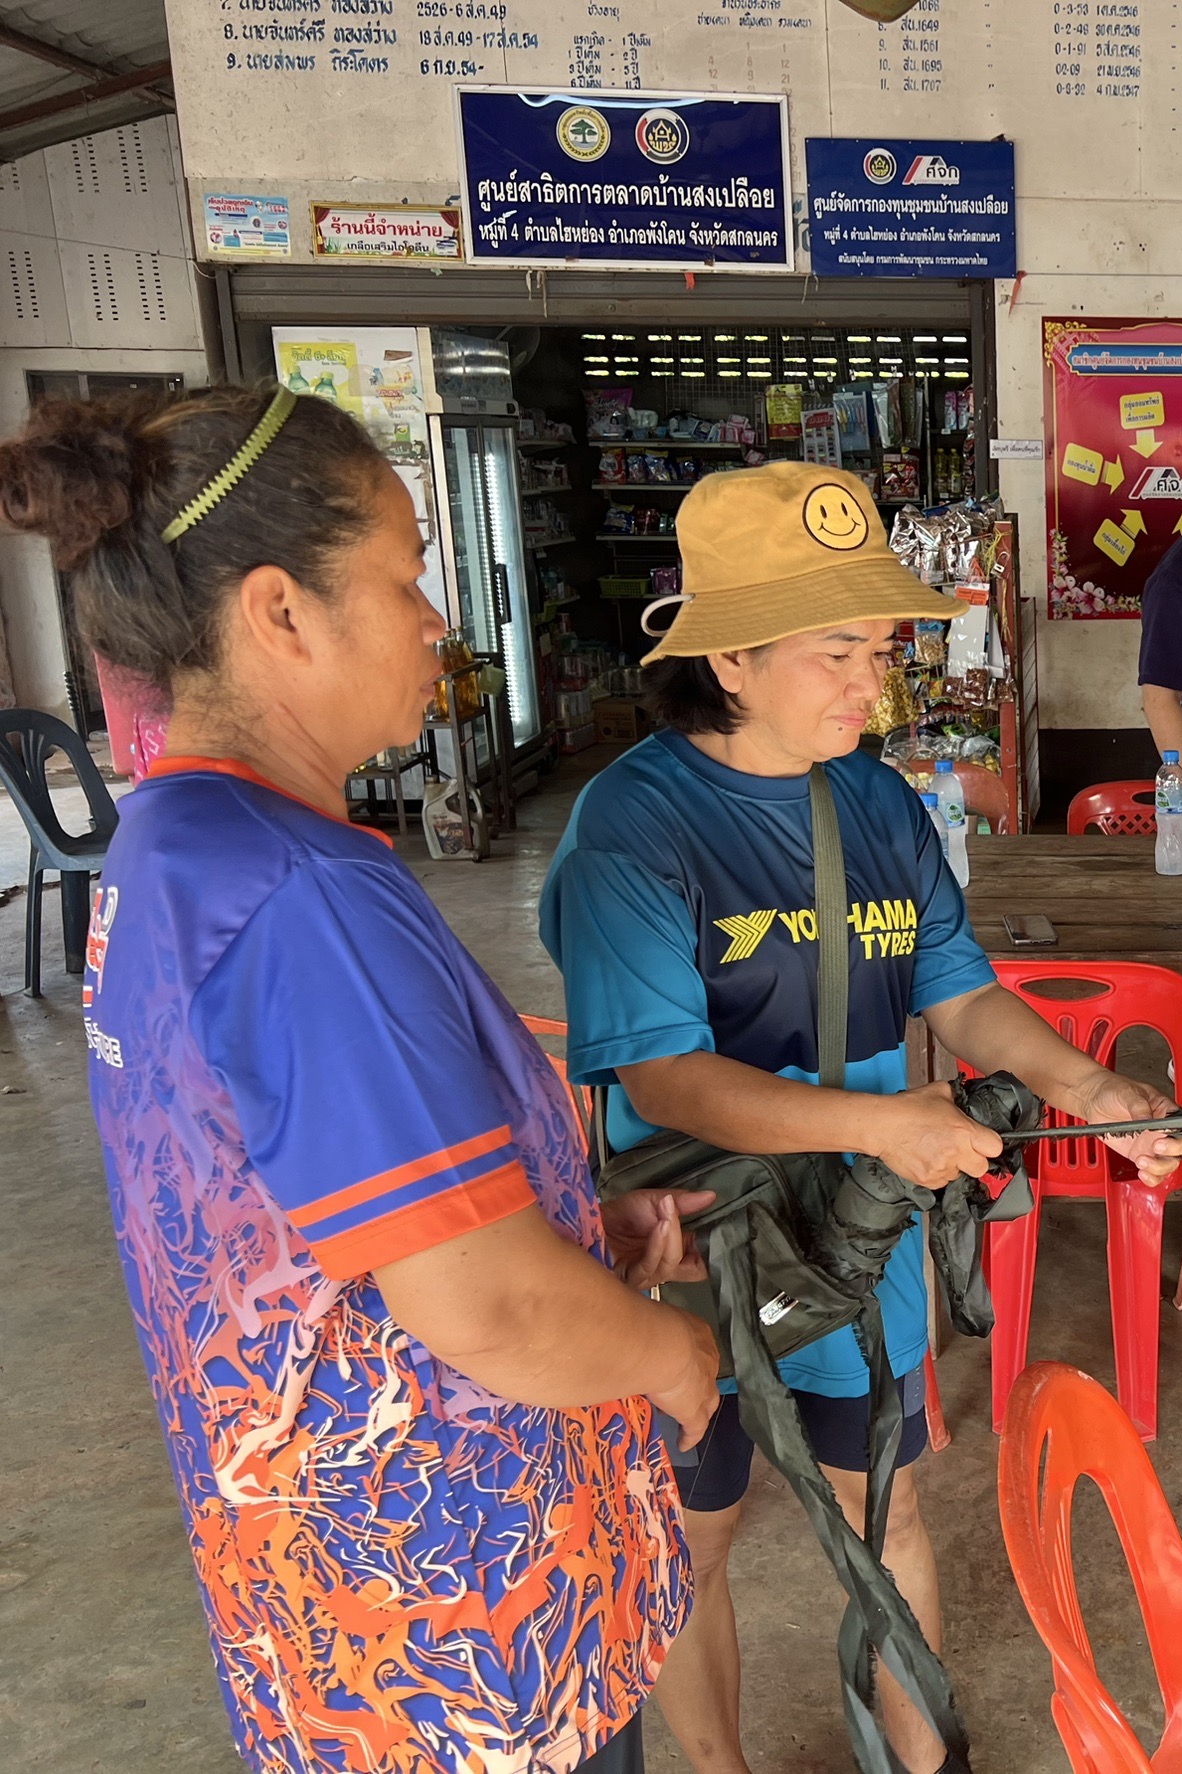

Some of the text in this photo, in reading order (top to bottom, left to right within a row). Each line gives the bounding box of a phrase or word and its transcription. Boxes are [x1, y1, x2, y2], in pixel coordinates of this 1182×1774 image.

[478, 169, 775, 214] ศูนย์สาธิตการตลาดบ้านสงเปลือย
[814, 191, 1009, 220] ศูนย์จัดการกองทุนชุมชนบ้านสงเปลือย
[330, 213, 443, 238] ร้านนี้จำหน่าย
[511, 223, 518, 241] 4
[525, 218, 604, 243] ตำบลไฮหย่อง
[608, 219, 685, 245] อำเภอพังโคน
[690, 223, 778, 248] จังหวัดสกลนคร
[851, 225, 898, 241] ตำบลไฮหย่อง
[900, 226, 946, 241] อำเภอพังโคน
[948, 228, 1000, 243] จังหวัดสกลนคร
[778, 899, 917, 943] YOHAMA
[860, 931, 916, 960] TYRES
